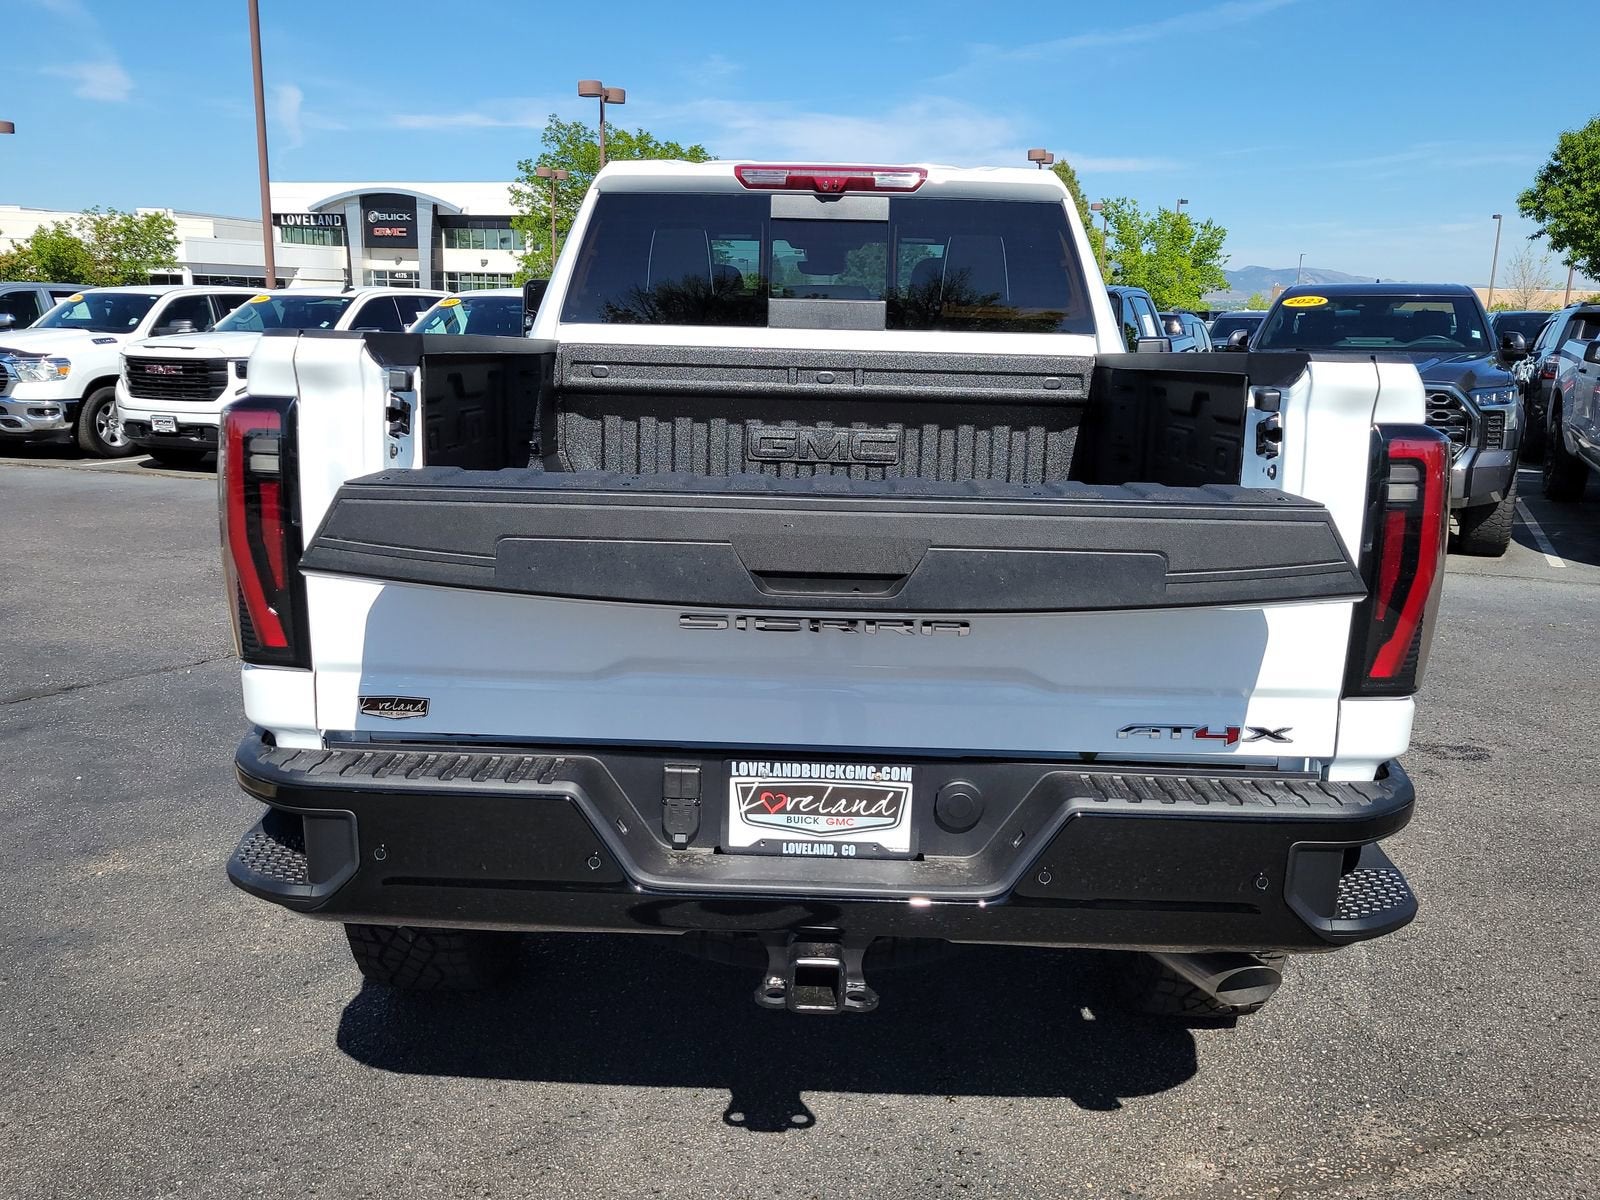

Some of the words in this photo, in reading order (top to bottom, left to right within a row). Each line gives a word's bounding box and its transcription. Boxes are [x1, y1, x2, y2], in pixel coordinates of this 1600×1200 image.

[280, 214, 341, 226] LOVELAND
[373, 227, 407, 236] GMC
[144, 364, 183, 375] GMC
[750, 430, 897, 462] GMC
[679, 614, 971, 637] SIERRA
[361, 697, 426, 711] Lveland
[731, 761, 912, 782] LOVELANDBUICKGMCCOM
[739, 782, 896, 816] Loveland
[786, 816, 819, 825] BUICK
[826, 817, 854, 826] GMC
[782, 842, 838, 856] LOVELAND,
[841, 844, 856, 856] CO
